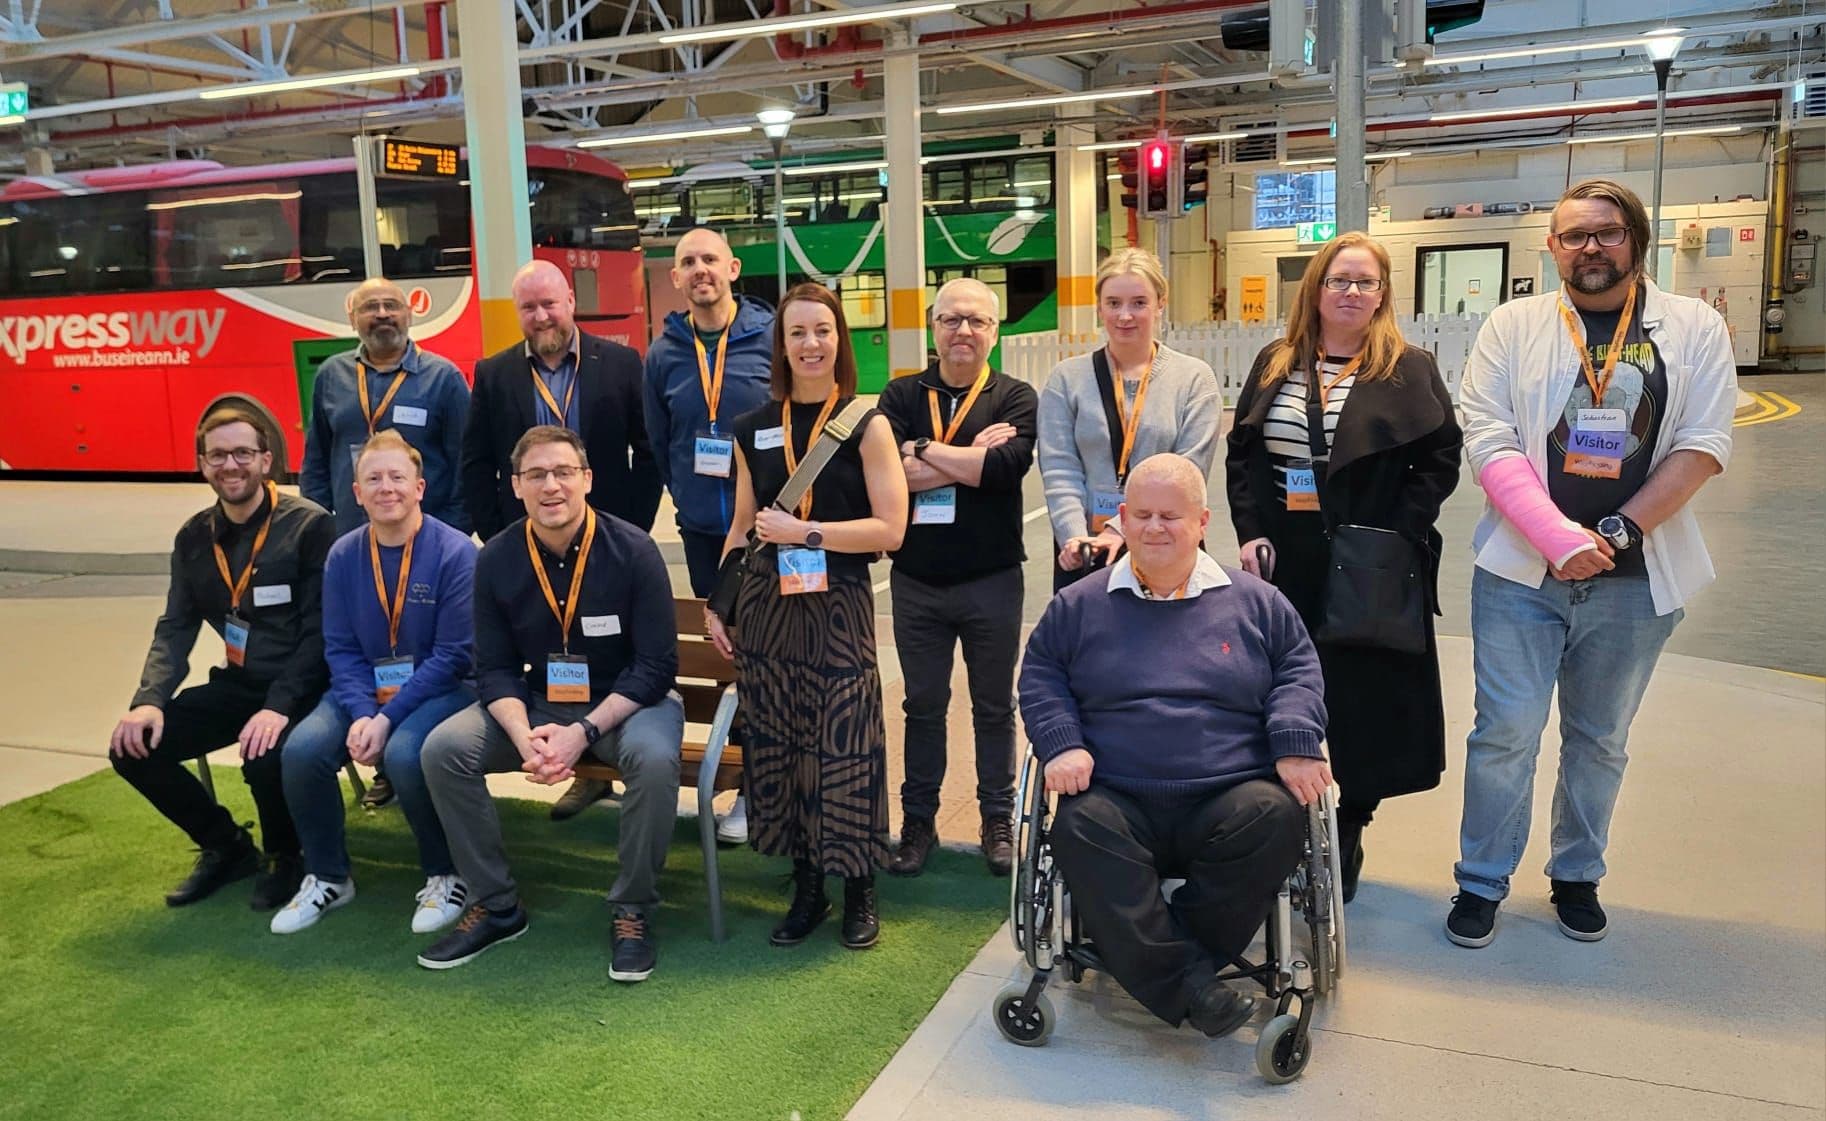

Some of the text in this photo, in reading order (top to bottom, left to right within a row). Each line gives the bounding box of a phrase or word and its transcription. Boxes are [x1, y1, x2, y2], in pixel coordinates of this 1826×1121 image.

[53, 347, 190, 367] www.buseireann.ie
[699, 441, 729, 455] Visitor
[1575, 434, 1620, 450] Visitor
[920, 494, 952, 503] Visitor
[551, 668, 585, 679] Visitor
